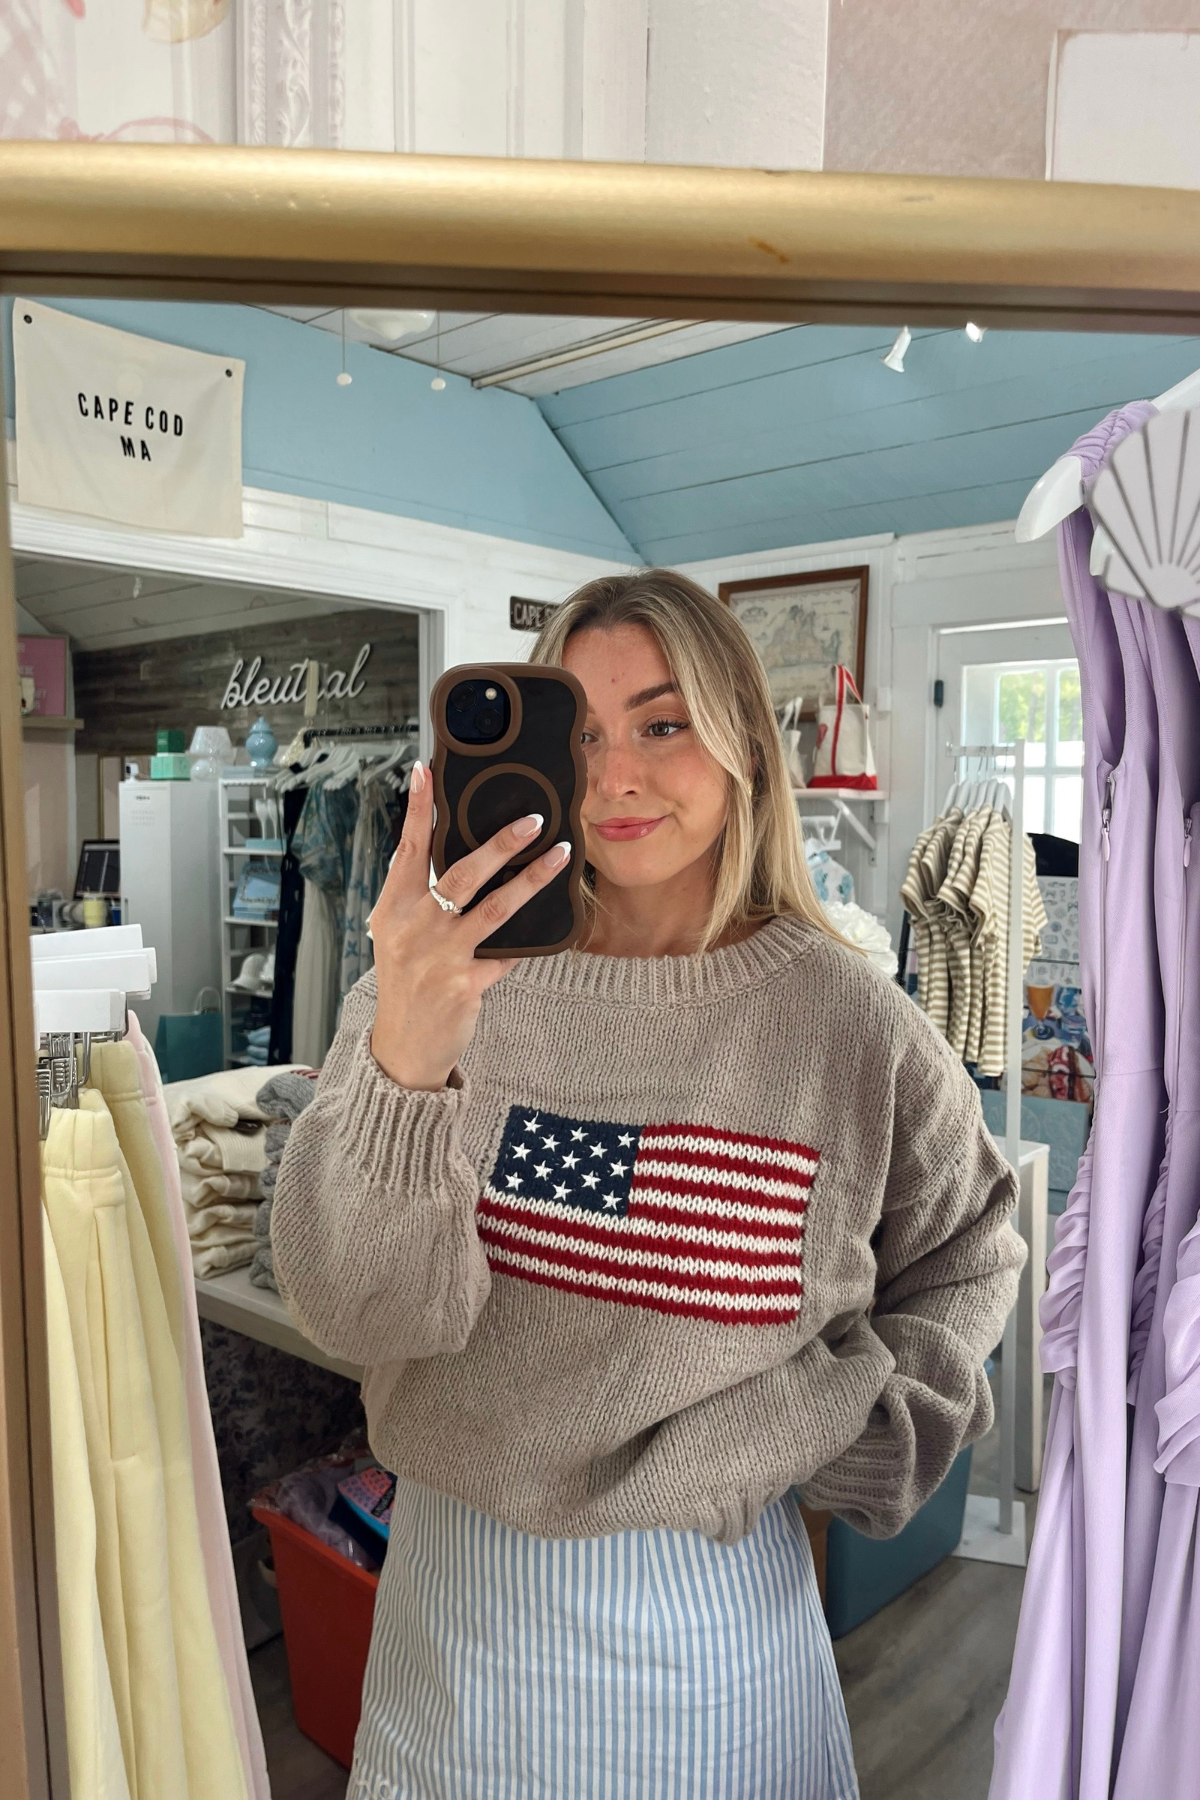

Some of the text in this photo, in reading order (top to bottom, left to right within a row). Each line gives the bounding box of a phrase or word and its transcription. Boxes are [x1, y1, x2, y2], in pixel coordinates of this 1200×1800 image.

[78, 393, 183, 436] CAPE COD
[120, 436, 151, 461] MA
[513, 603, 541, 628] CAPE
[220, 643, 371, 710] bleutal
